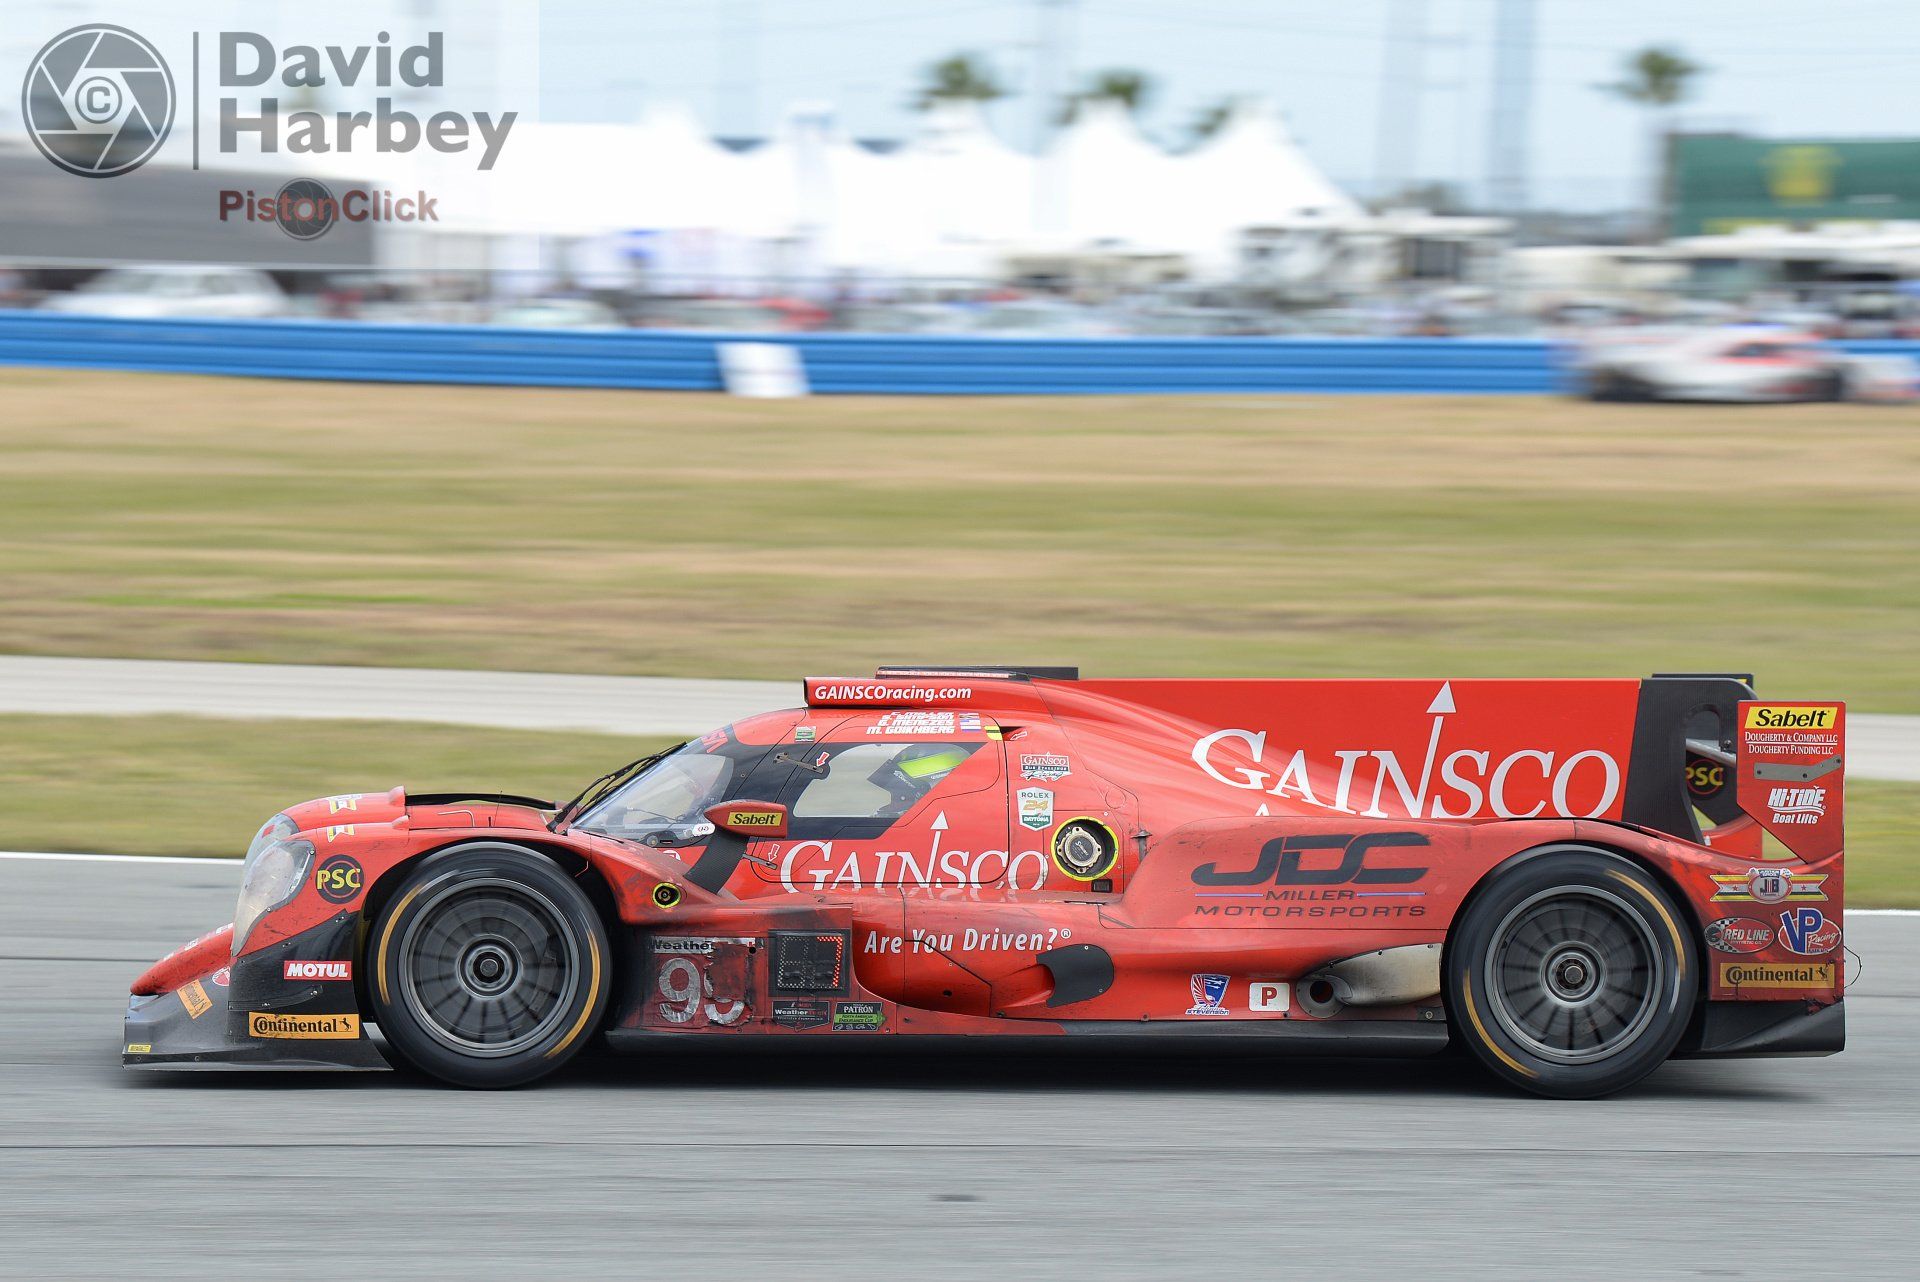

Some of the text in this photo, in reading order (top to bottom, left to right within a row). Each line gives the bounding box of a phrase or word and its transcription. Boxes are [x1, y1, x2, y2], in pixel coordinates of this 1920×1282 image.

[815, 684, 972, 703] GAINSCOracing.com
[1755, 708, 1828, 727] Sabelt
[1826, 735, 1838, 743] LLC
[1823, 746, 1834, 755] LLC
[1023, 755, 1066, 766] GAINSCO
[1191, 728, 1621, 819] GAINSCO
[733, 813, 777, 825] Sabelt
[1772, 813, 1819, 825] Boat Lifts
[780, 840, 1047, 892] GAINSCO
[1190, 831, 1431, 886] JDC
[316, 868, 362, 890] PSC
[1265, 889, 1355, 901] MILLER
[1195, 905, 1426, 918] MOTORSPORTS
[864, 930, 902, 954] Are
[911, 929, 956, 954] You
[1724, 929, 1771, 941] RED LINE
[286, 963, 349, 978] MOTUL
[1726, 965, 1814, 985] Continental
[1261, 986, 1278, 1006] P
[253, 1015, 337, 1034] Continental
